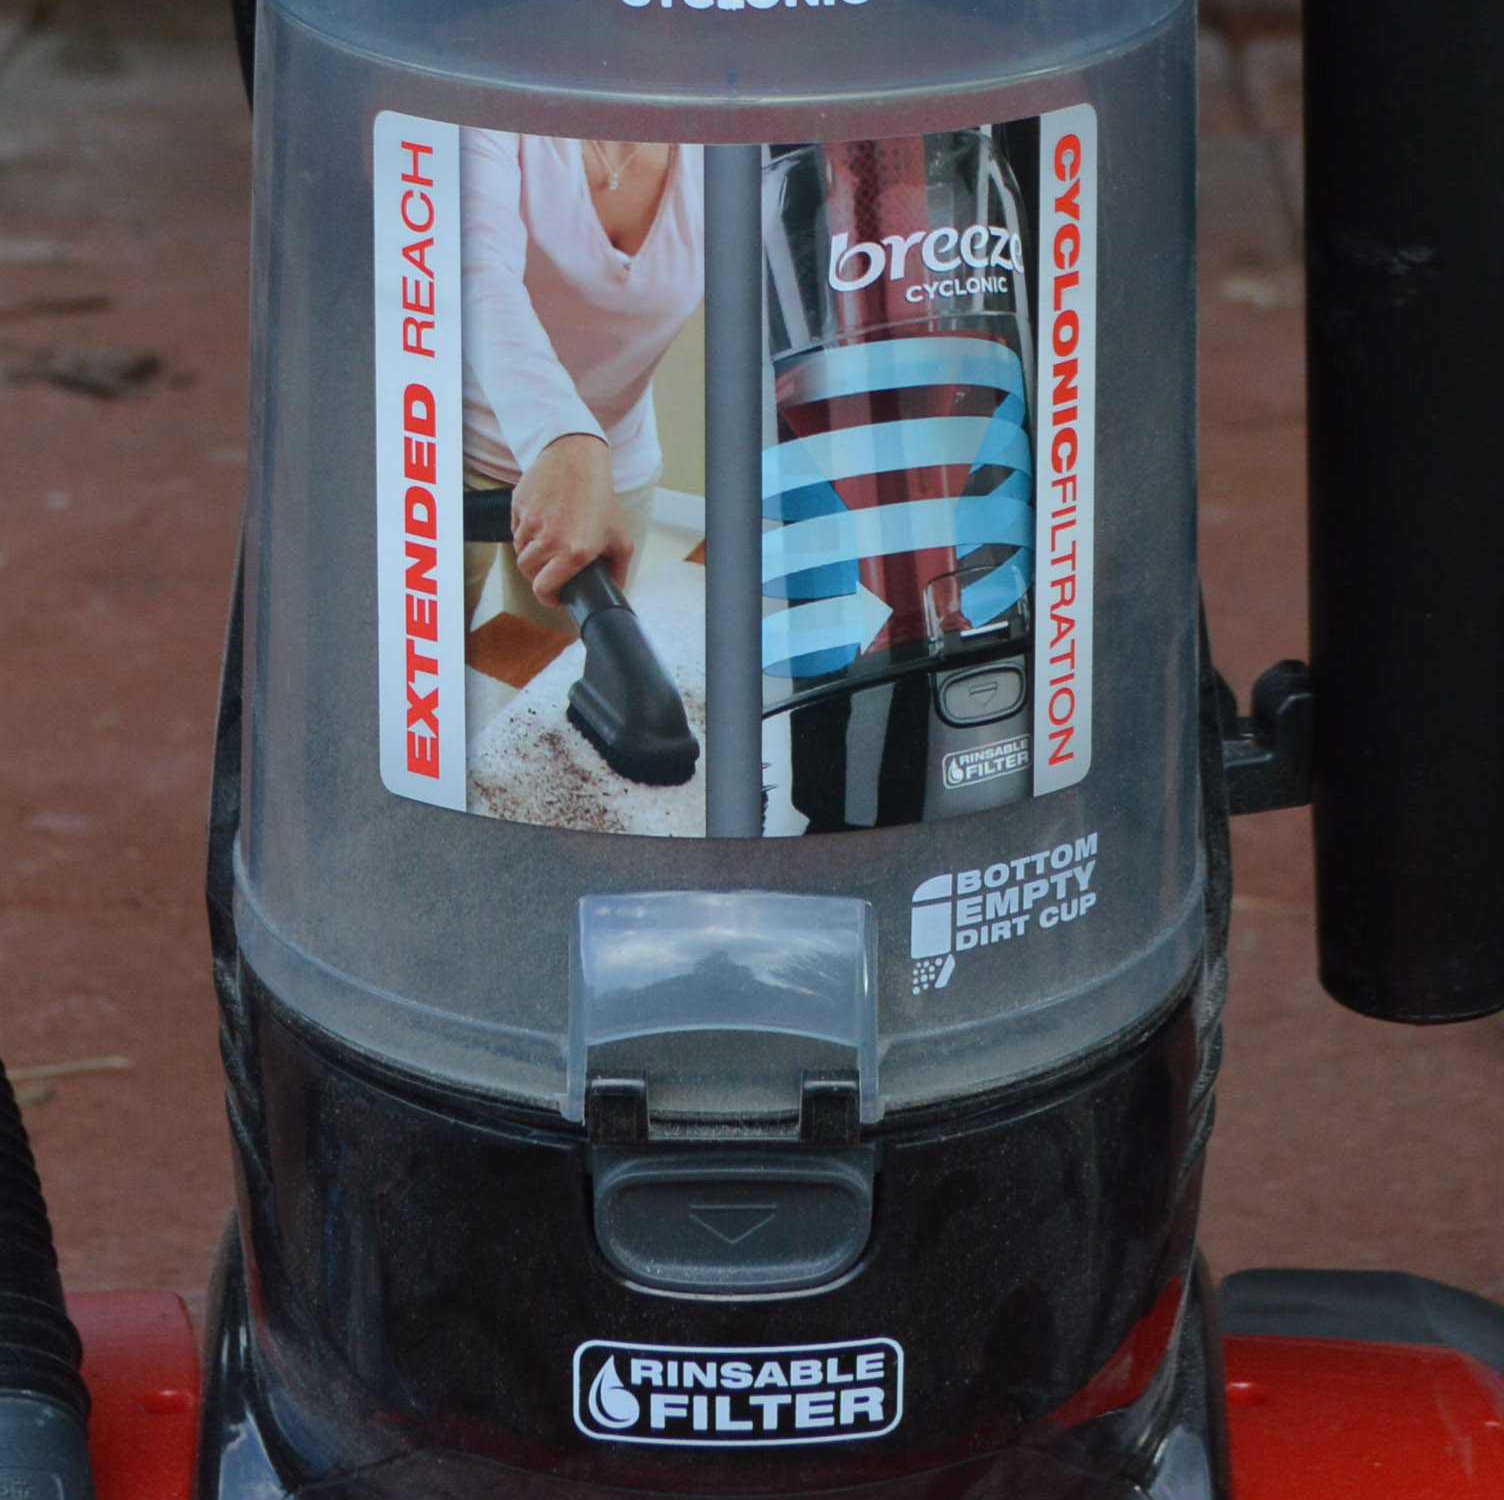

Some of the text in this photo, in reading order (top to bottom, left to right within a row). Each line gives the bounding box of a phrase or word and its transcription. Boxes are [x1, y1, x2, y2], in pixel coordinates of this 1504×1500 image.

[829, 224, 1025, 292] breeze
[906, 275, 1008, 303] CYCLONIC
[400, 139, 440, 779] EXTENDED REACH
[959, 738, 1029, 766] RINSABLE
[966, 750, 1030, 780] FILTER
[956, 832, 1098, 896] BOTTOM
[956, 859, 1096, 927] EMPTY
[955, 891, 1097, 952] DIRT CUP
[630, 1352, 885, 1389] RINSABLE
[649, 1386, 885, 1431] FILTER
